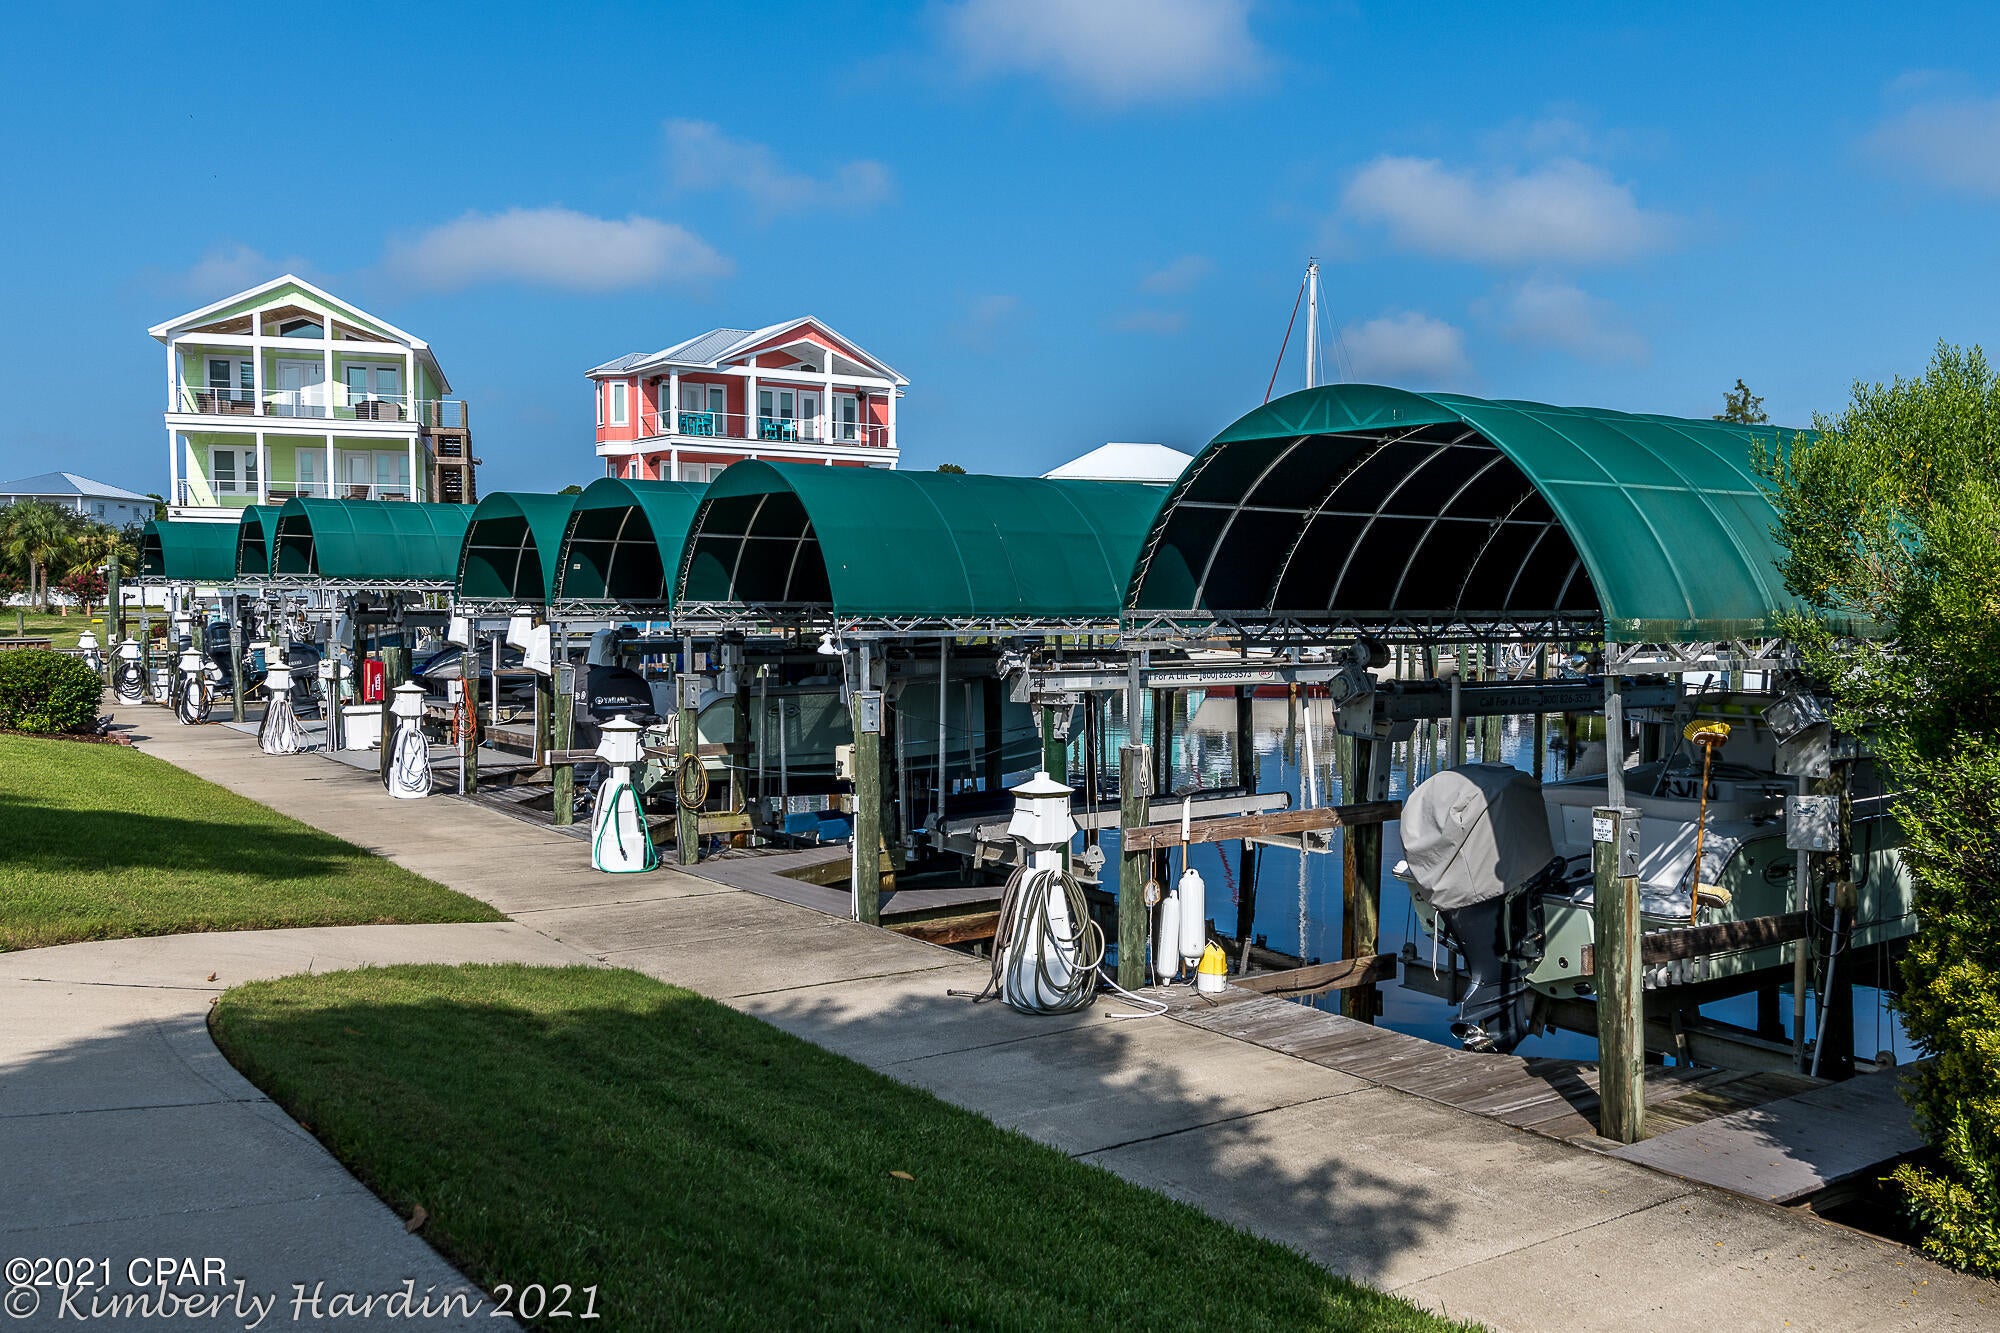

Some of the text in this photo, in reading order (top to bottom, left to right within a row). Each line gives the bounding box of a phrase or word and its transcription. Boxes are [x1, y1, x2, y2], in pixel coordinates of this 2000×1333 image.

[1154, 672, 1166, 680] For
[1168, 672, 1175, 680] A
[1176, 671, 1189, 680] Lift
